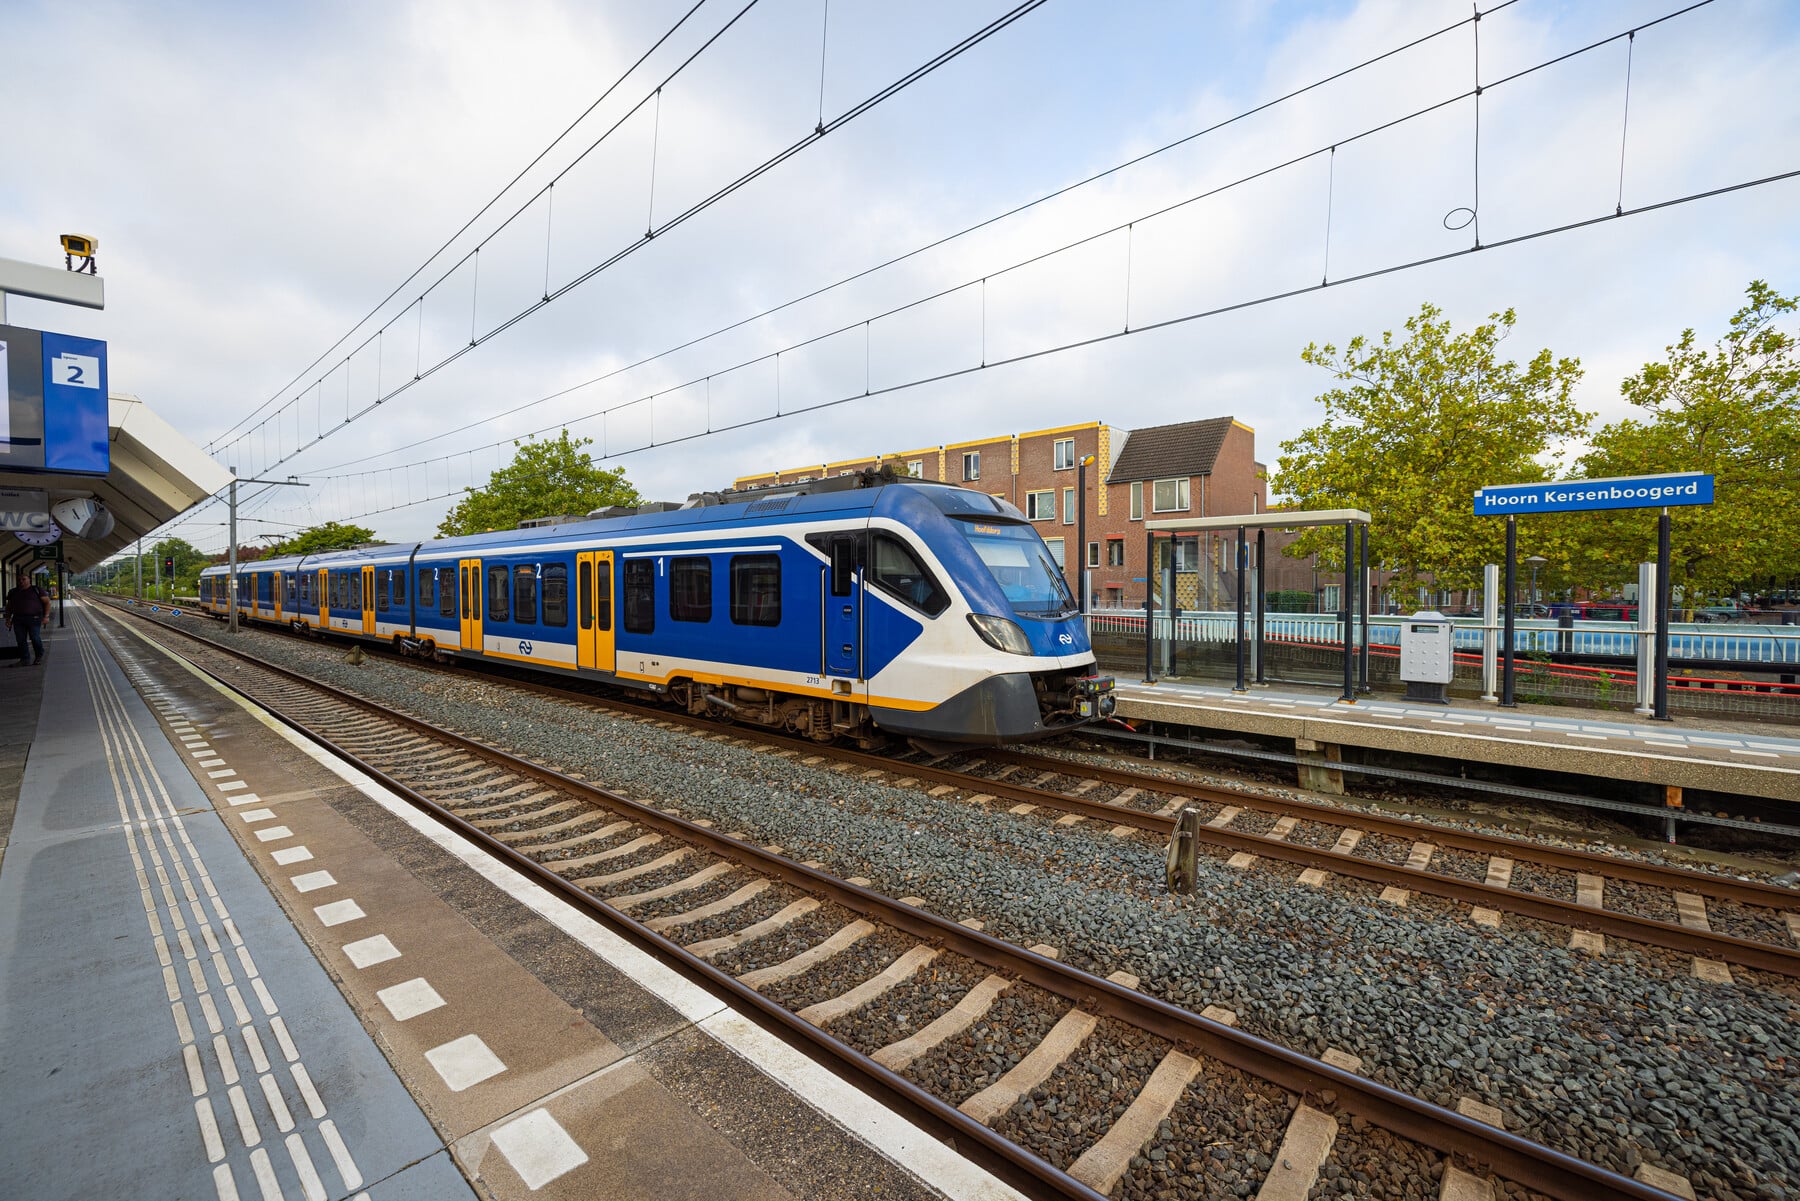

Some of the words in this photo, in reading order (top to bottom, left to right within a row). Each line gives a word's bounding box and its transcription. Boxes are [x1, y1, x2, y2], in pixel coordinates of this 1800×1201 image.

[67, 366, 84, 384] 2
[1485, 495, 1538, 506] Hoorn
[1545, 482, 1698, 503] Kersenboogerd
[0, 512, 44, 528] WC
[434, 567, 439, 580] 2
[536, 563, 542, 579] 2
[658, 557, 664, 577] 1
[388, 570, 393, 581] 2
[806, 676, 820, 685] 2713
